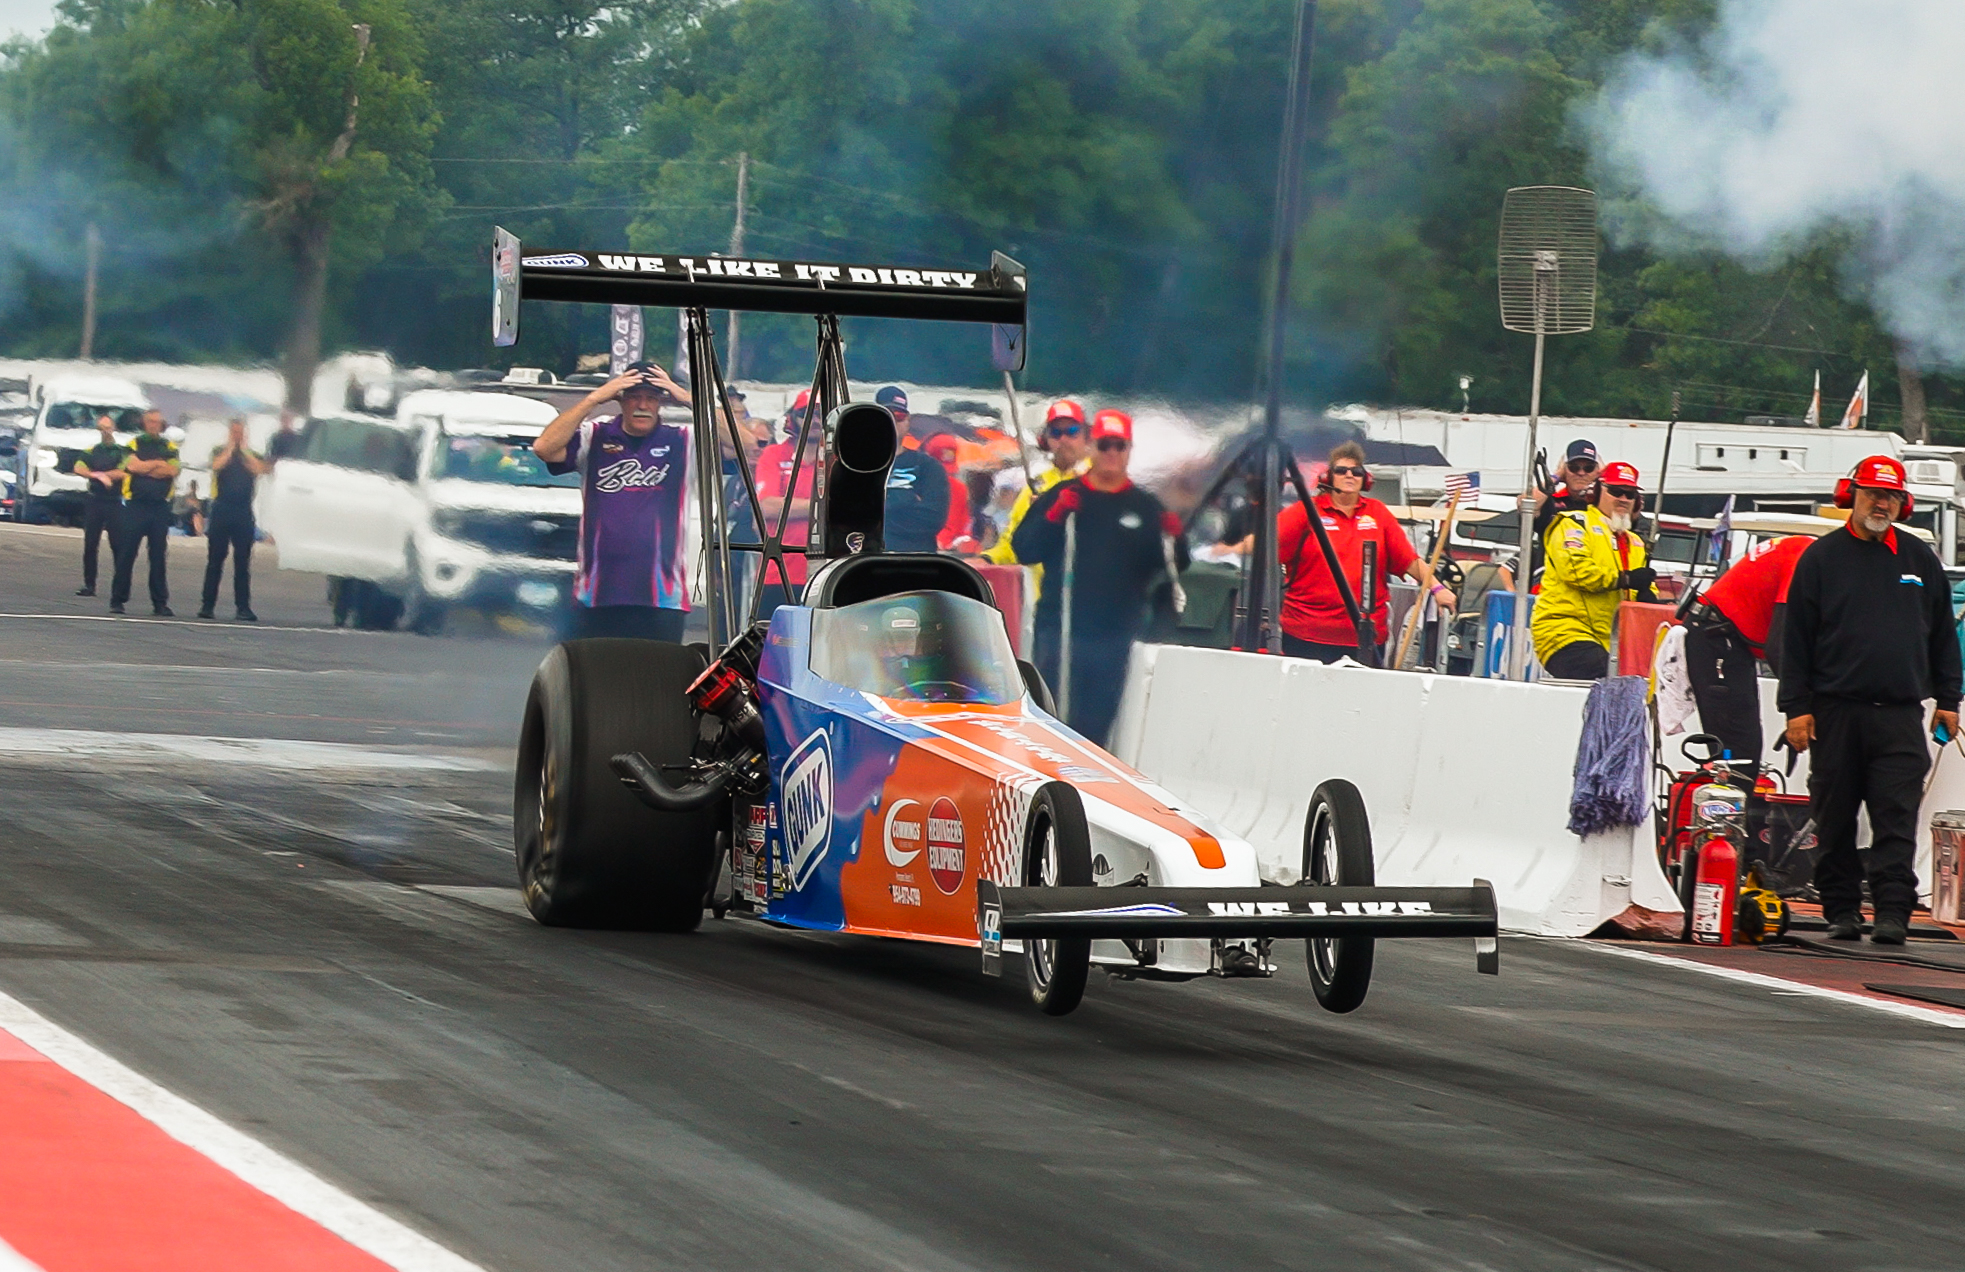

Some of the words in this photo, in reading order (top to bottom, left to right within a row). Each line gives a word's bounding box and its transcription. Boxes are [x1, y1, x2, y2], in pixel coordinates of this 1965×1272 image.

[598, 254, 667, 273] WE
[678, 258, 782, 278] LIKE
[794, 264, 841, 282] IT
[848, 267, 977, 289] DIRTY
[787, 760, 826, 857] GUNK
[928, 845, 964, 872] EQUIPMENT
